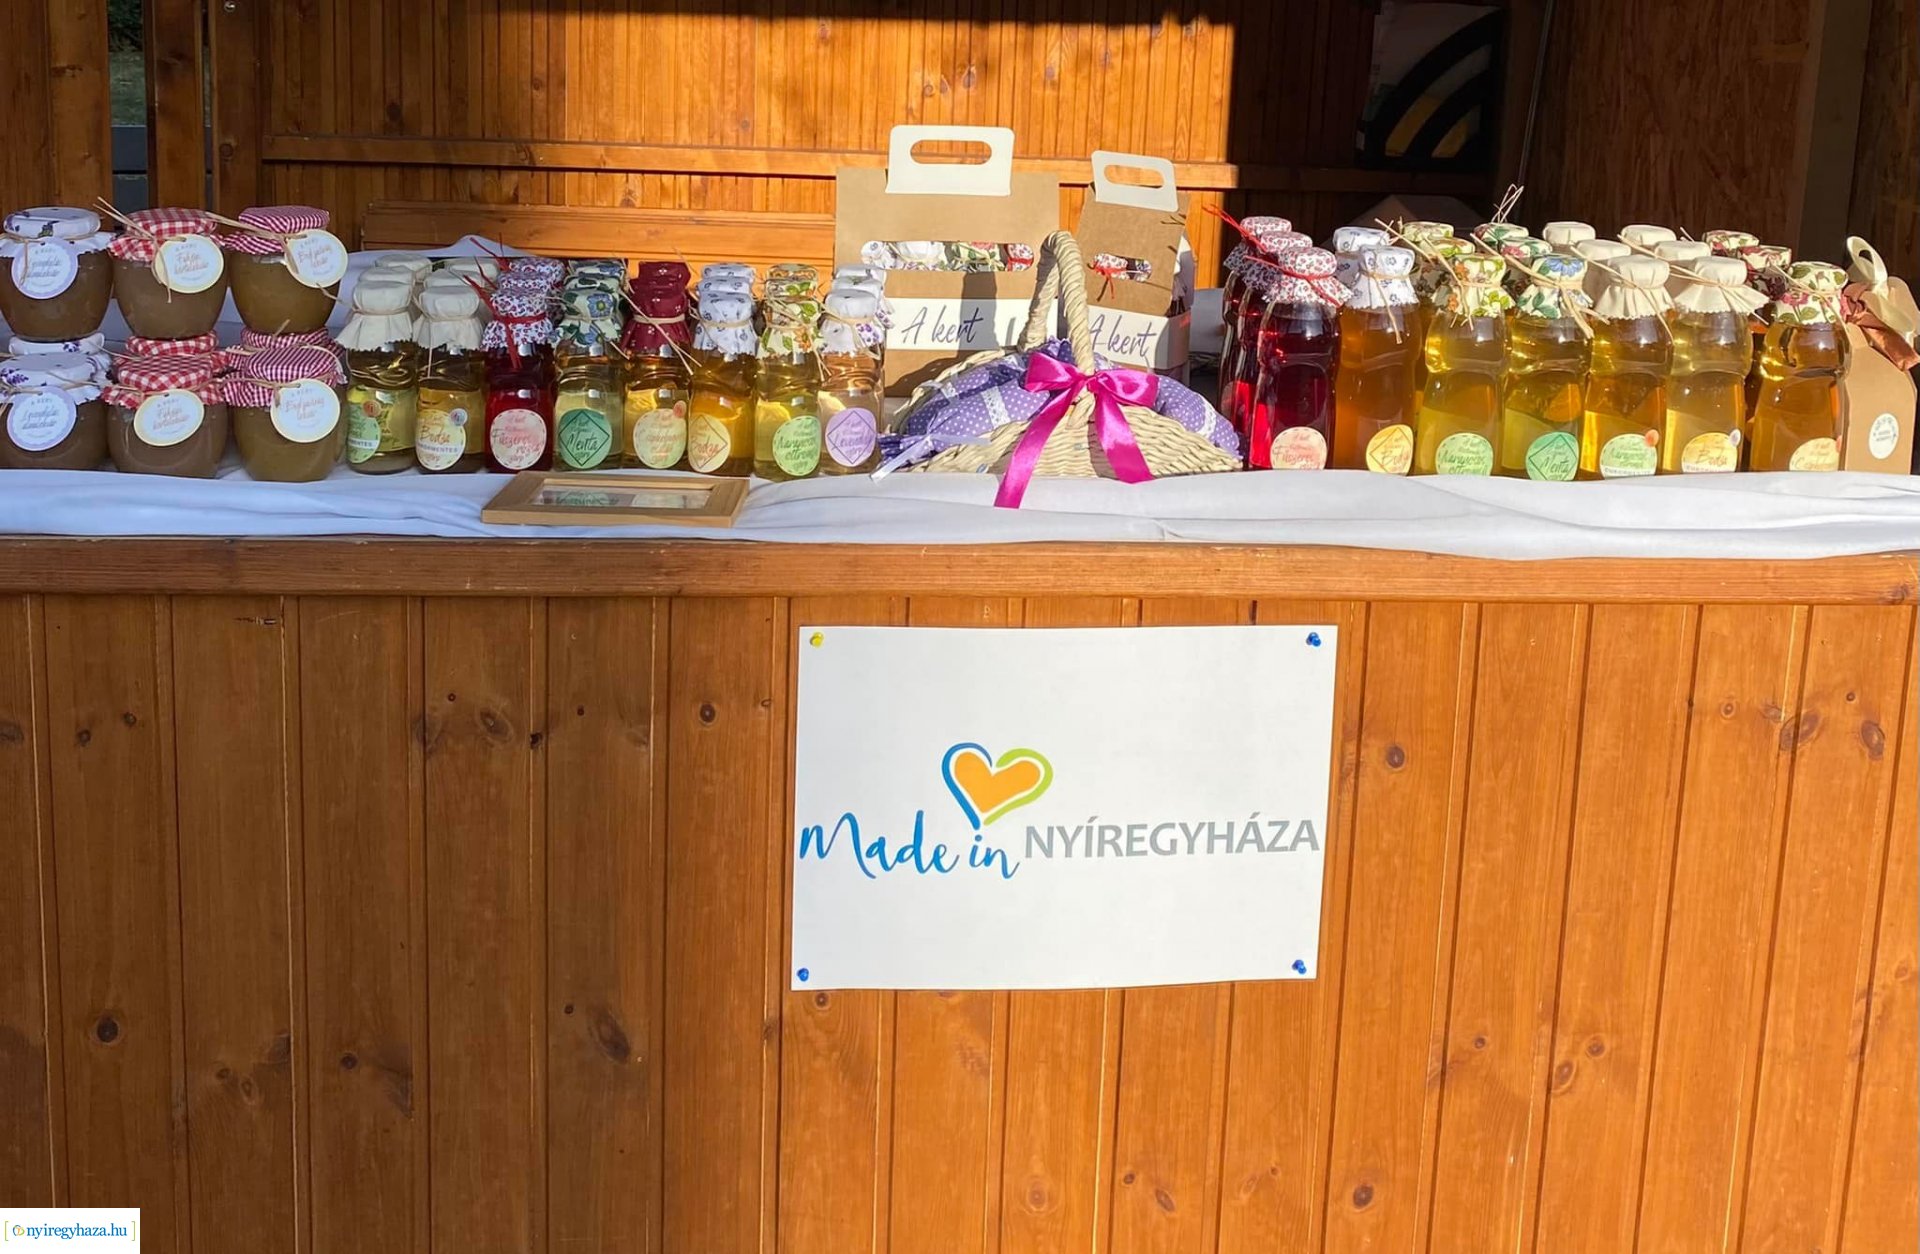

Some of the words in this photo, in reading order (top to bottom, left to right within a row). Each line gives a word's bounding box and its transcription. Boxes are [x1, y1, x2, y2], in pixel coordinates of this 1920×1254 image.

[901, 306, 927, 344] A
[931, 305, 984, 344] kert
[1108, 316, 1158, 357] kert
[566, 431, 598, 452] Menta
[800, 810, 959, 879] Made
[968, 834, 1019, 879] in
[1025, 811, 1320, 859] NYÍREGYHÁZA
